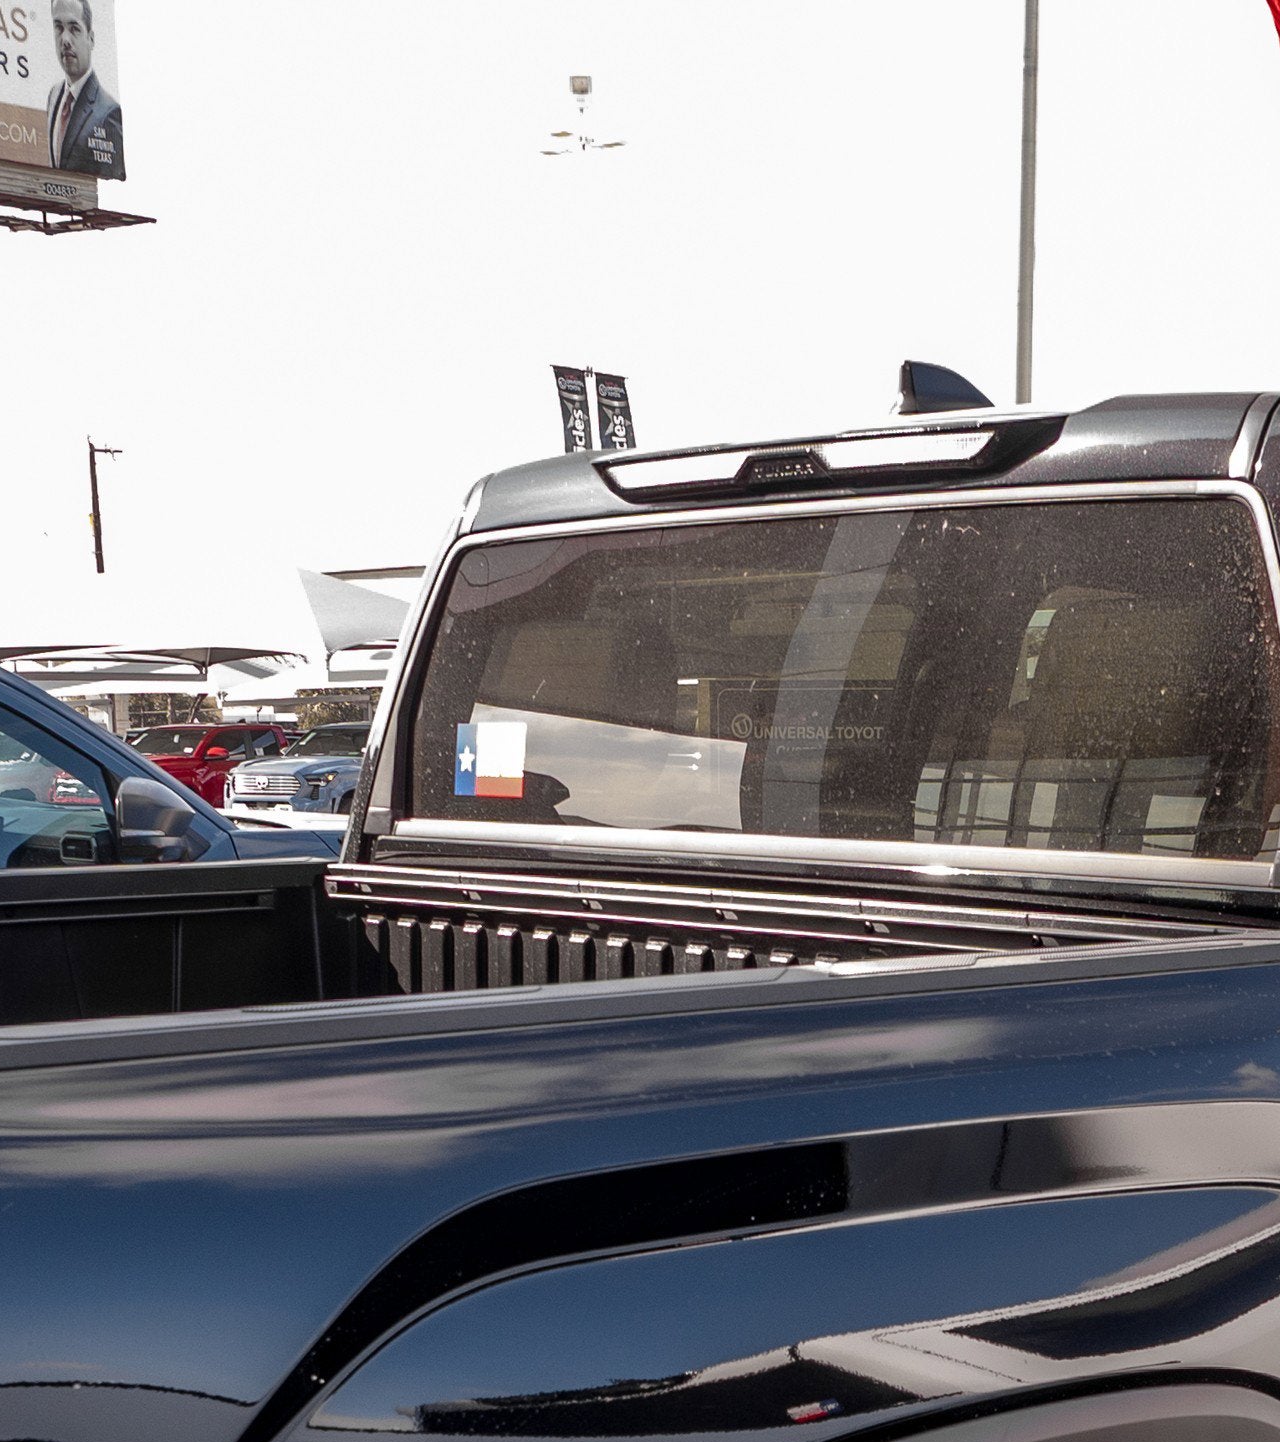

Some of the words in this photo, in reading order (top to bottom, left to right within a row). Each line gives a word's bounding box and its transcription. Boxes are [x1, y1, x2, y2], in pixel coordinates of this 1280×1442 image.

[93, 126, 106, 139] SAN
[92, 150, 112, 165] TEXAS
[754, 726, 834, 739] UNIVERSAL
[835, 726, 884, 739] TOYOT
